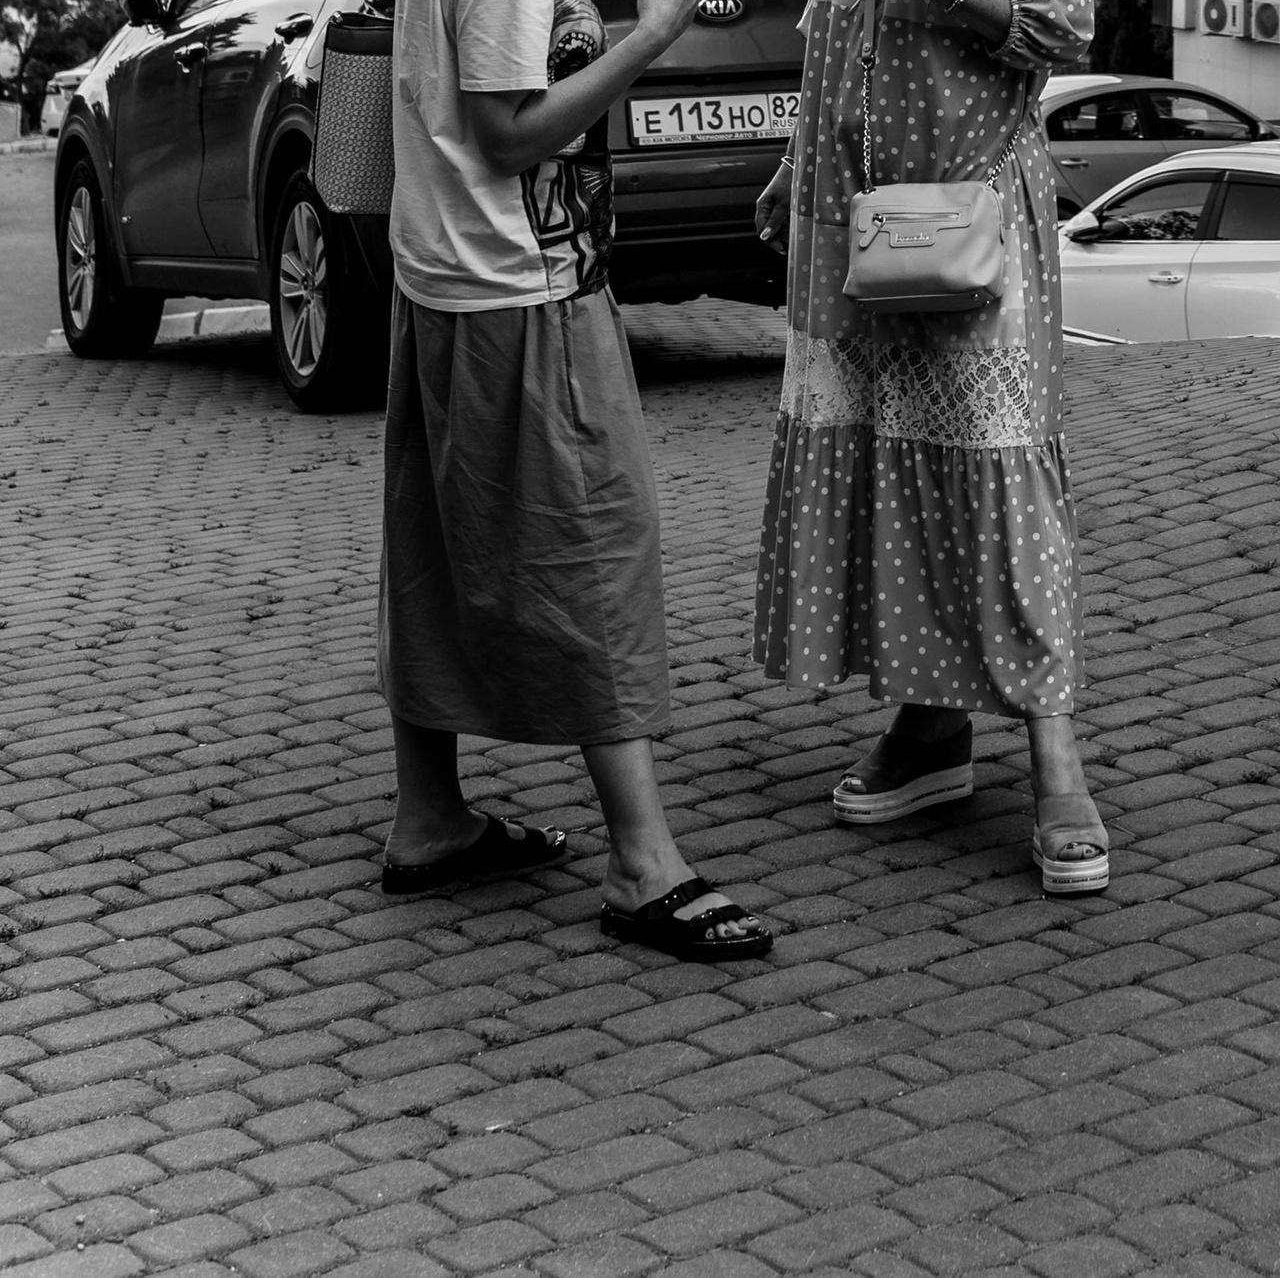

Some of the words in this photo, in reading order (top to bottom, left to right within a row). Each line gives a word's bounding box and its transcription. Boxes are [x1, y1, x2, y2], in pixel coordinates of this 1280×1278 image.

[705, 0, 737, 14] KIA
[772, 95, 799, 118] 82
[772, 118, 794, 129] RUS
